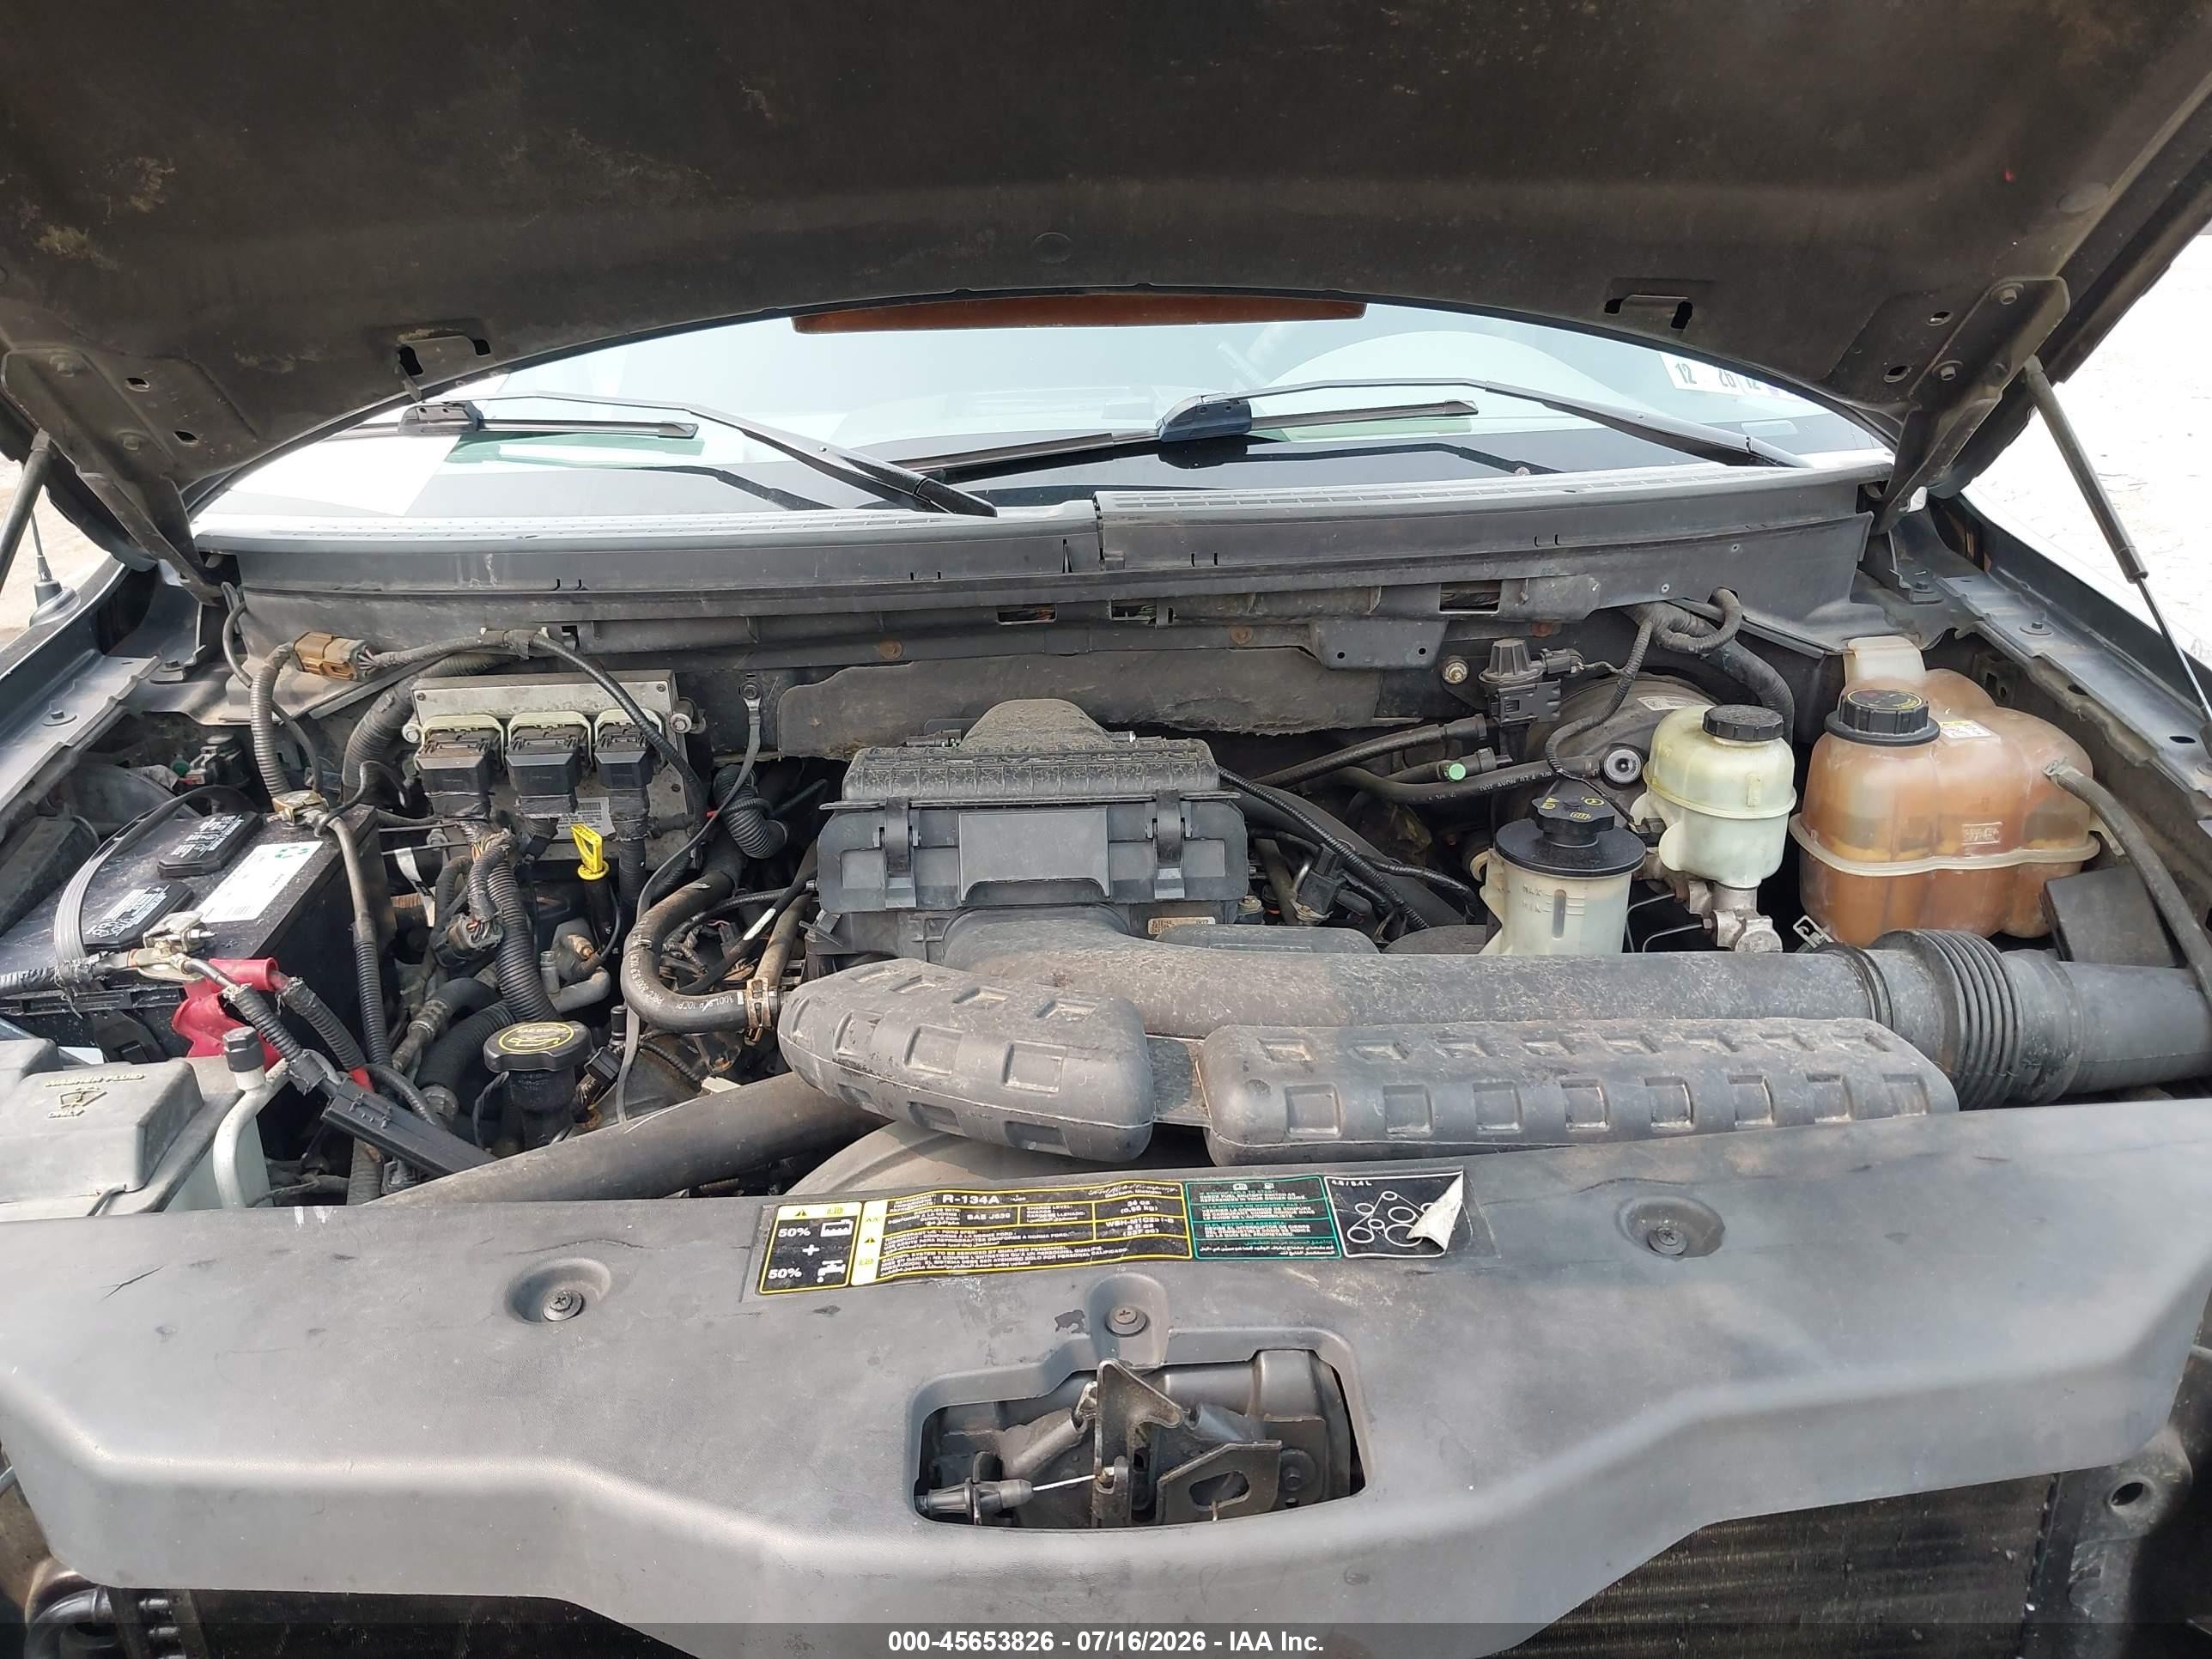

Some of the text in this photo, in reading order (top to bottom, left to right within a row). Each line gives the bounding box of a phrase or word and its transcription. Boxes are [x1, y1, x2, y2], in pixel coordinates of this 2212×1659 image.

[1675, 362, 1697, 385] 12
[943, 1194, 1000, 1204] R-134A
[778, 1227, 811, 1238] 50%
[768, 1267, 803, 1279] 50%
